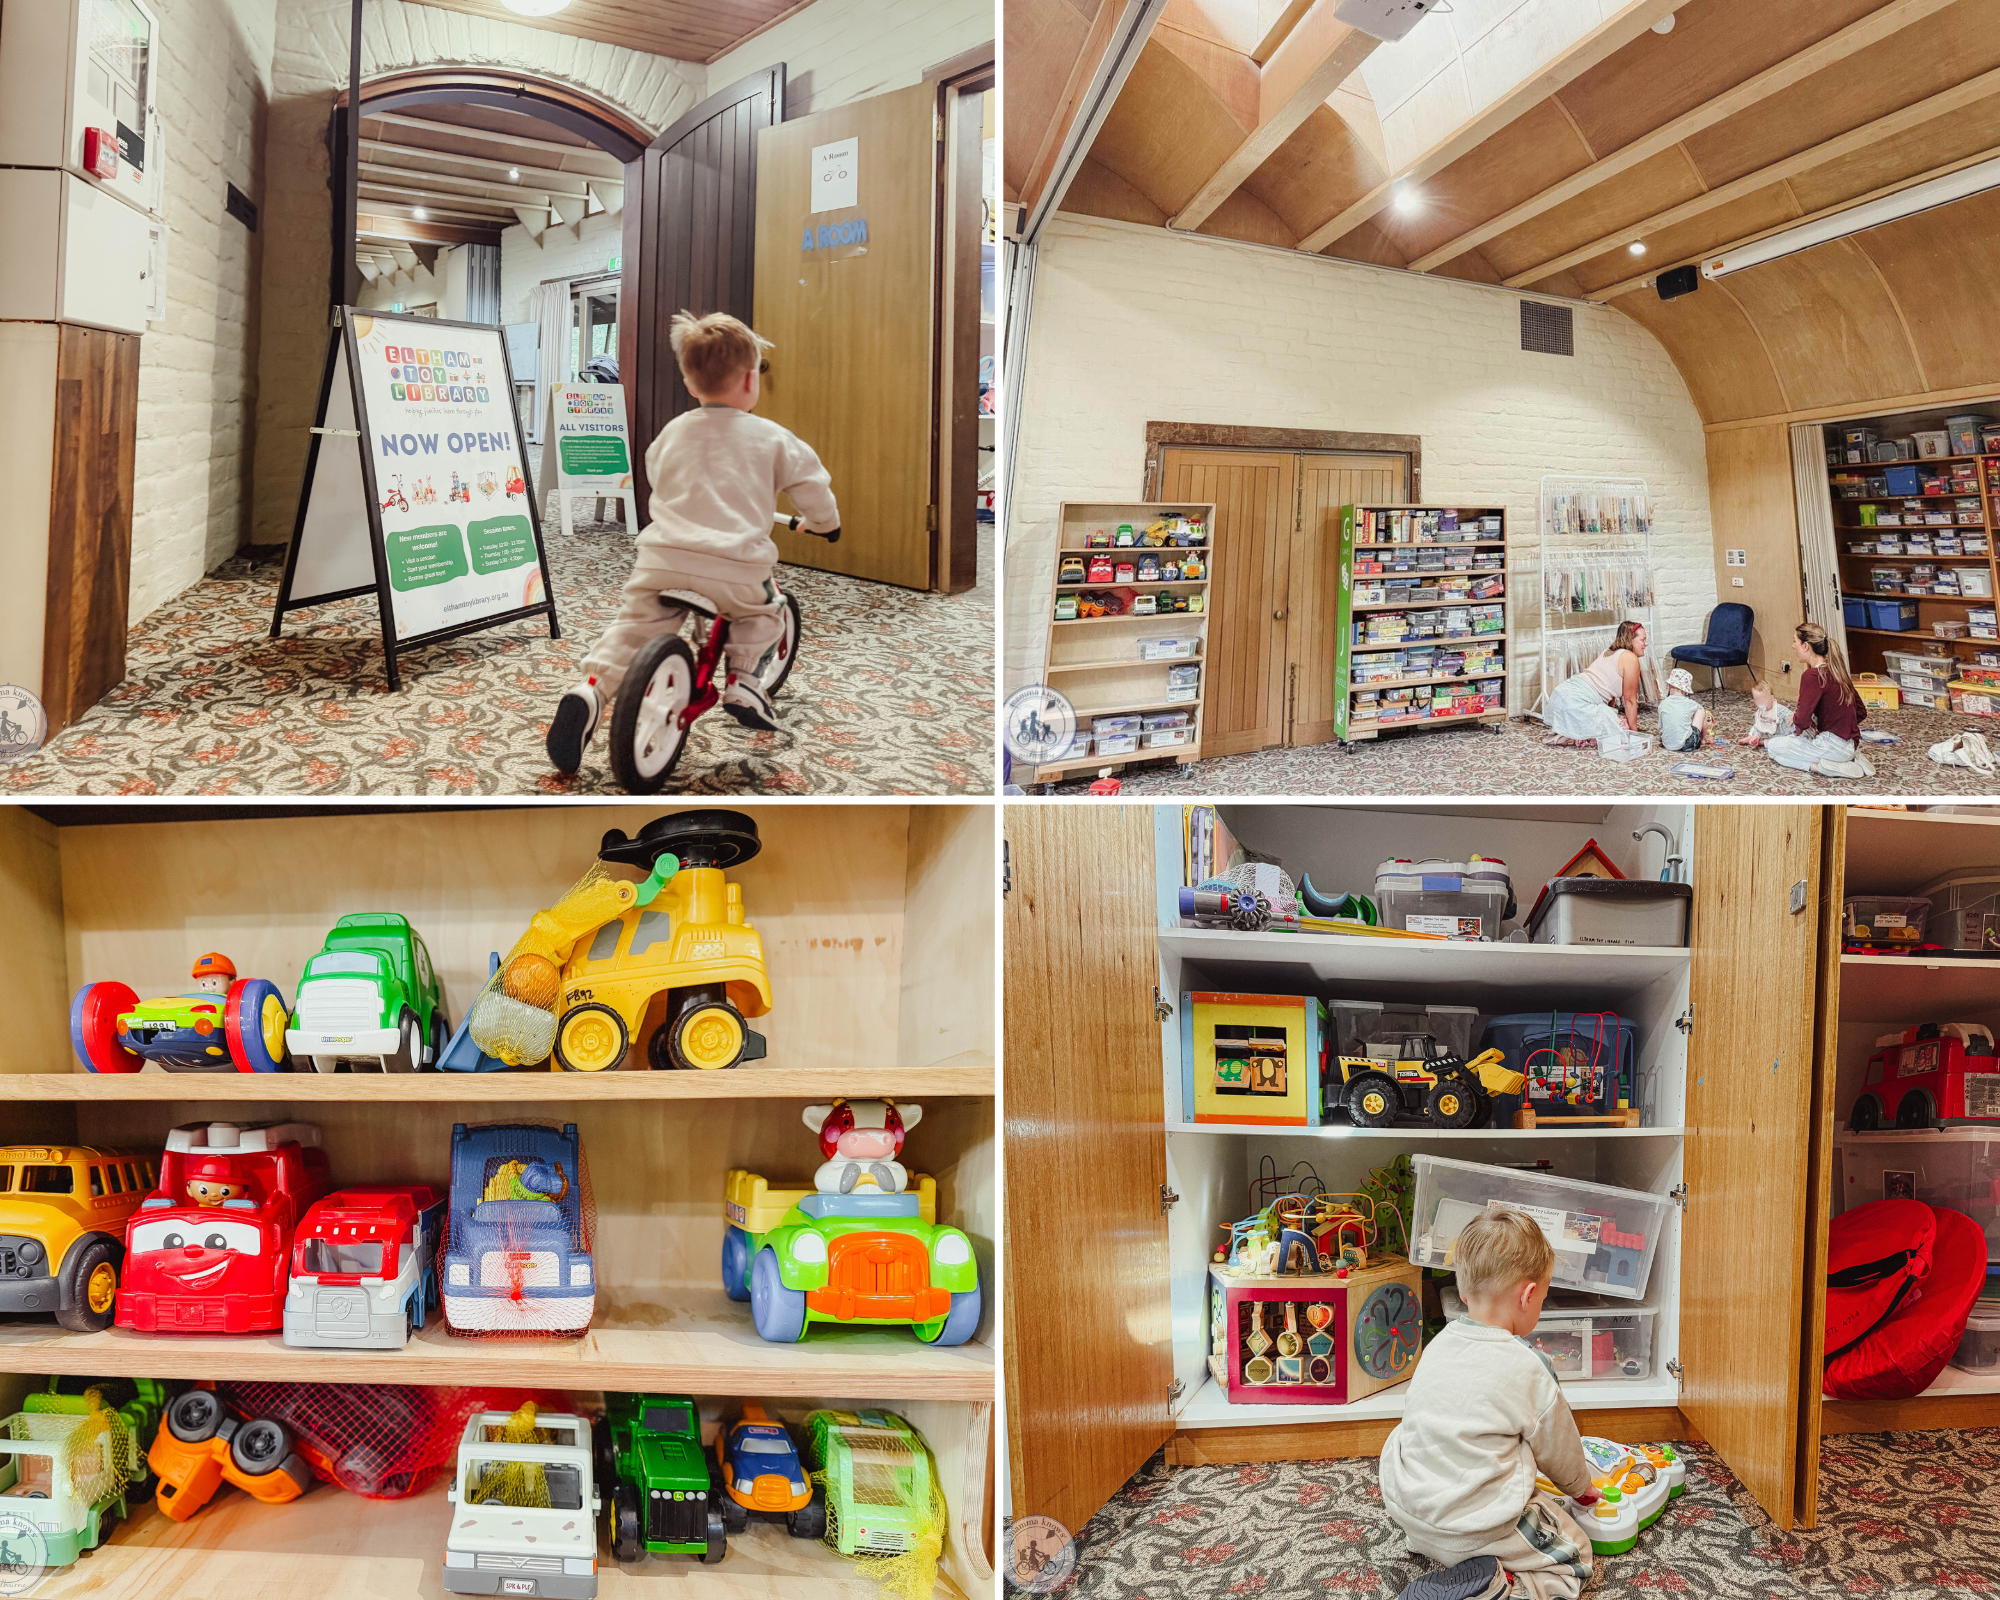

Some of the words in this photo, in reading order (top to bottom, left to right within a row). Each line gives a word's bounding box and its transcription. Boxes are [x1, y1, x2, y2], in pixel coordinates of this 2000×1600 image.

[829, 150, 849, 160] Room
[802, 227, 815, 252] A
[818, 218, 868, 250] ROOM
[386, 346, 470, 368] ELTHAM
[404, 366, 446, 384] TOY
[392, 383, 489, 402] LIBRARY
[560, 424, 576, 432] ALL
[579, 424, 624, 432] VISITORS
[381, 433, 439, 456] NOW
[447, 432, 511, 454] OPEN!
[399, 535, 412, 543] New
[412, 531, 438, 541] members
[1343, 517, 1350, 541] G
[412, 541, 438, 551] welcome!
[566, 989, 595, 1006] F892
[29, 1151, 47, 1159] Bus
